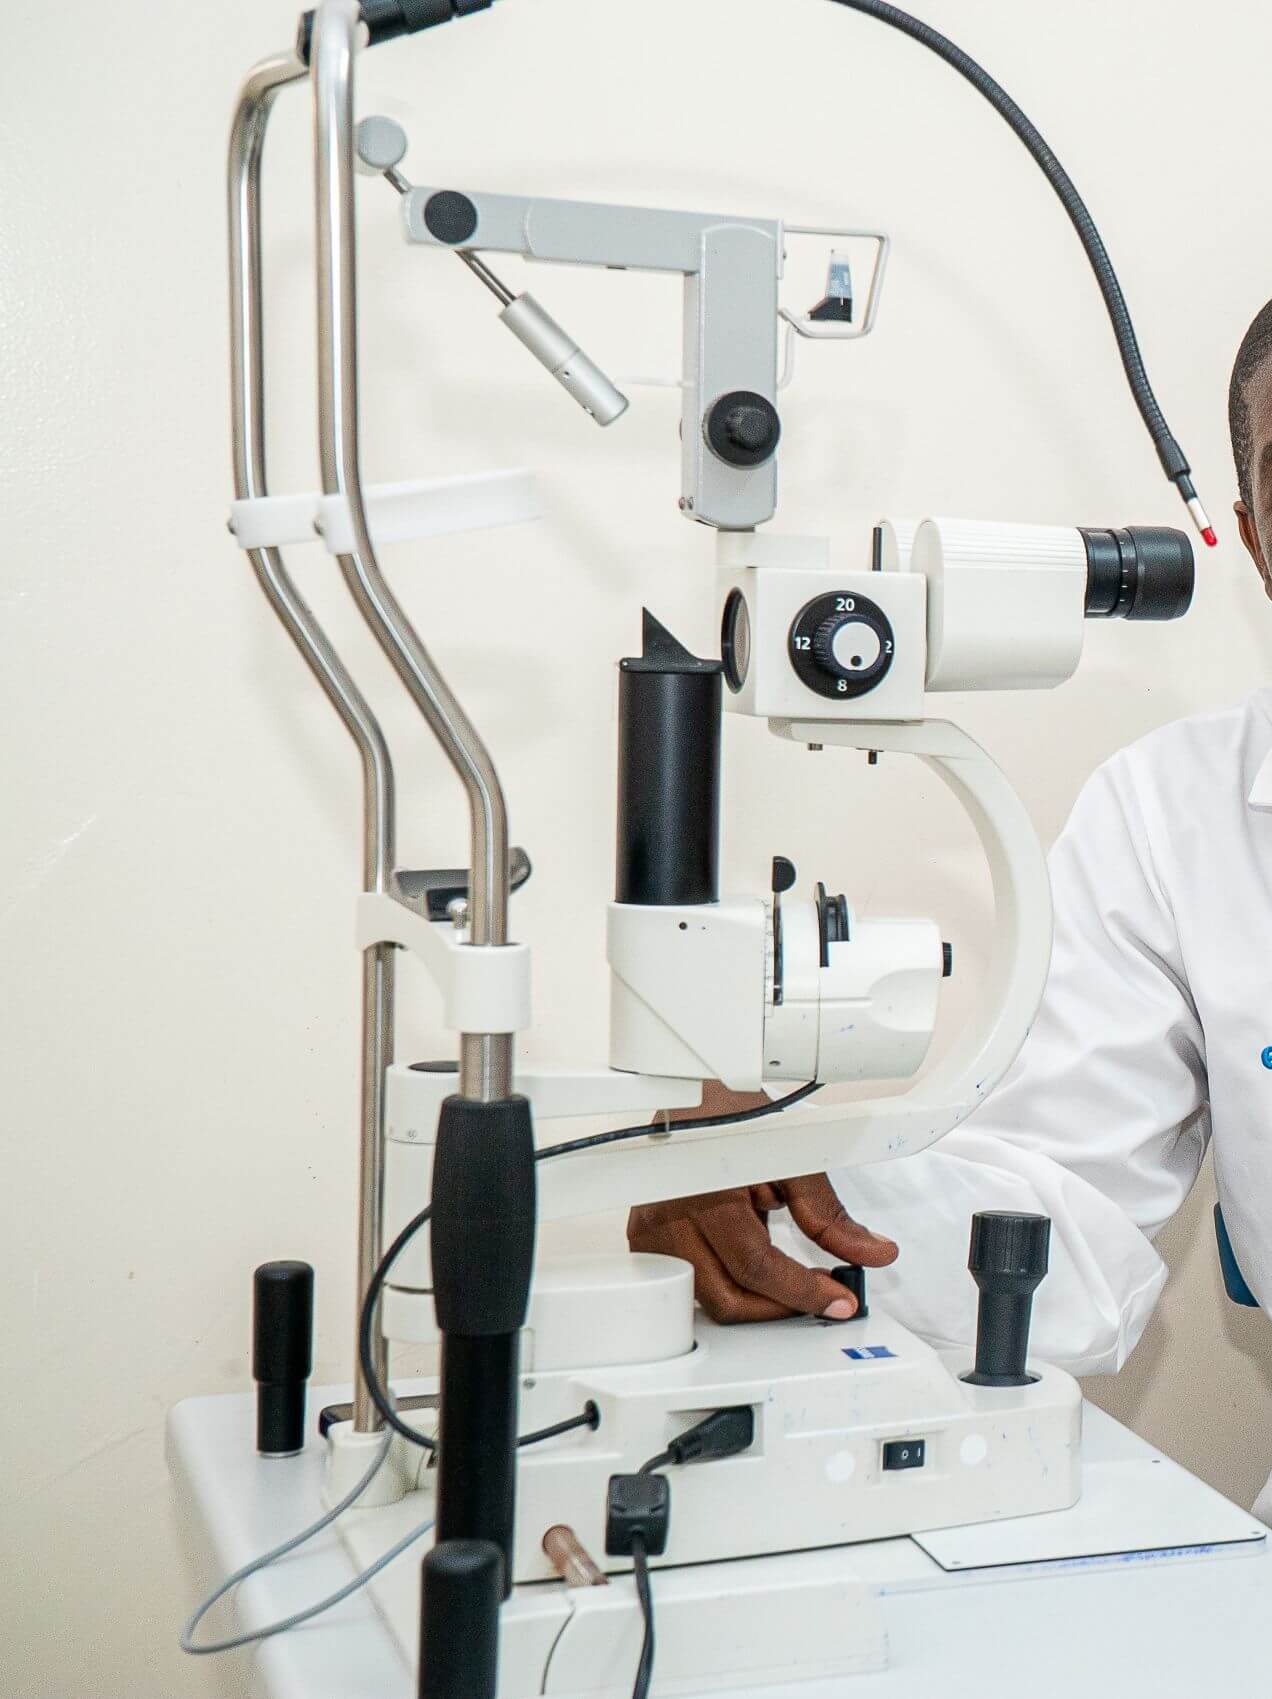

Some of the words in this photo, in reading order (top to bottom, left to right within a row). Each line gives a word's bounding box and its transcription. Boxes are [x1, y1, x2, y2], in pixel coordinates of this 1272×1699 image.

[836, 598, 855, 611] 20
[795, 637, 811, 650] 12
[837, 679, 848, 692] 8
